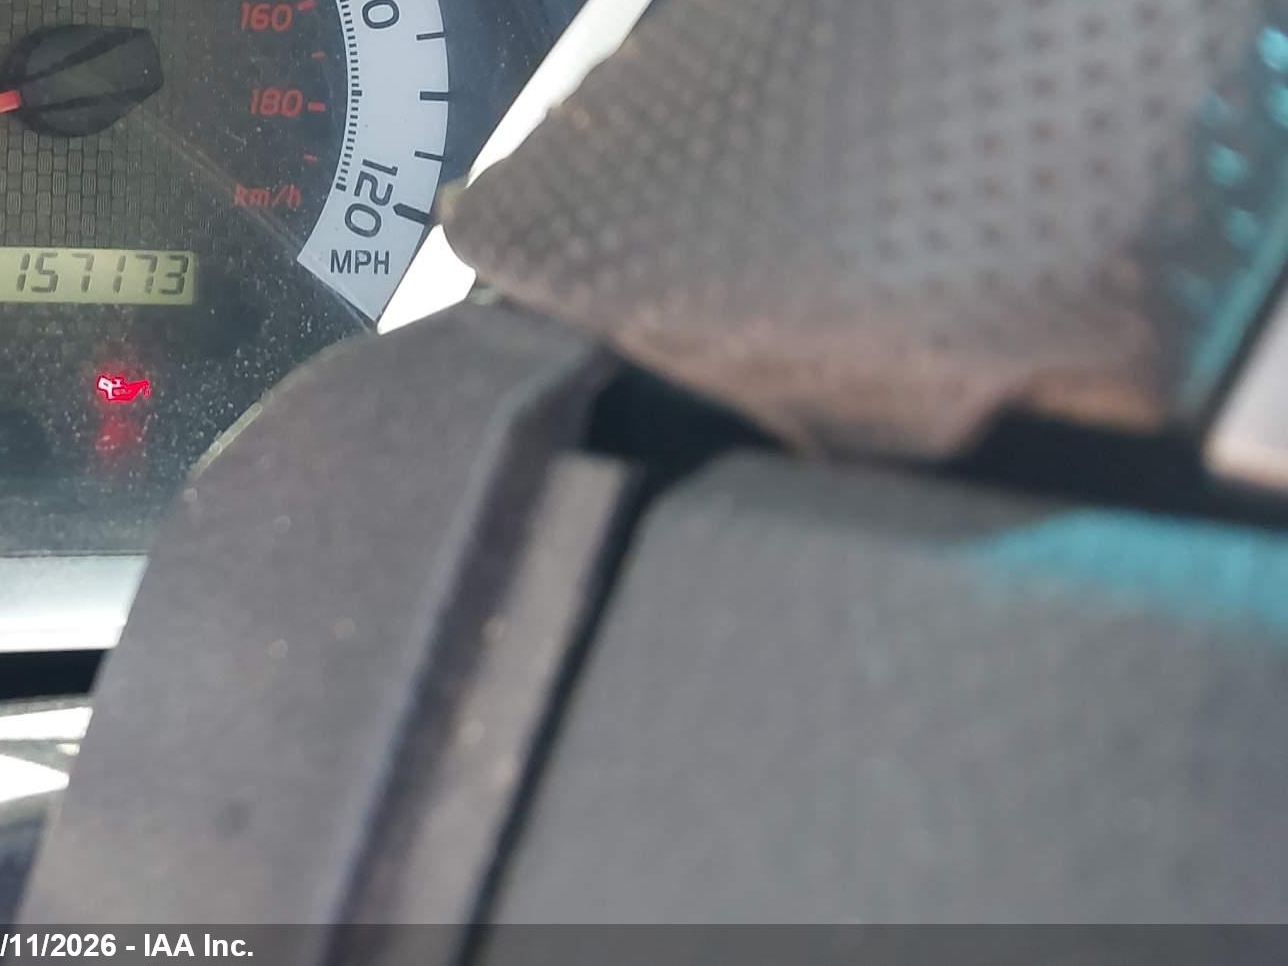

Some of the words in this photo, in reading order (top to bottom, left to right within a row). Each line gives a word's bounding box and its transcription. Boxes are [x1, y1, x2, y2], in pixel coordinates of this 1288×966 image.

[240, 2, 293, 32] 160
[249, 89, 303, 117] 180
[232, 185, 302, 208] km/h
[344, 159, 399, 238] 120
[15, 251, 189, 296] 157173
[330, 249, 391, 275] MPH
